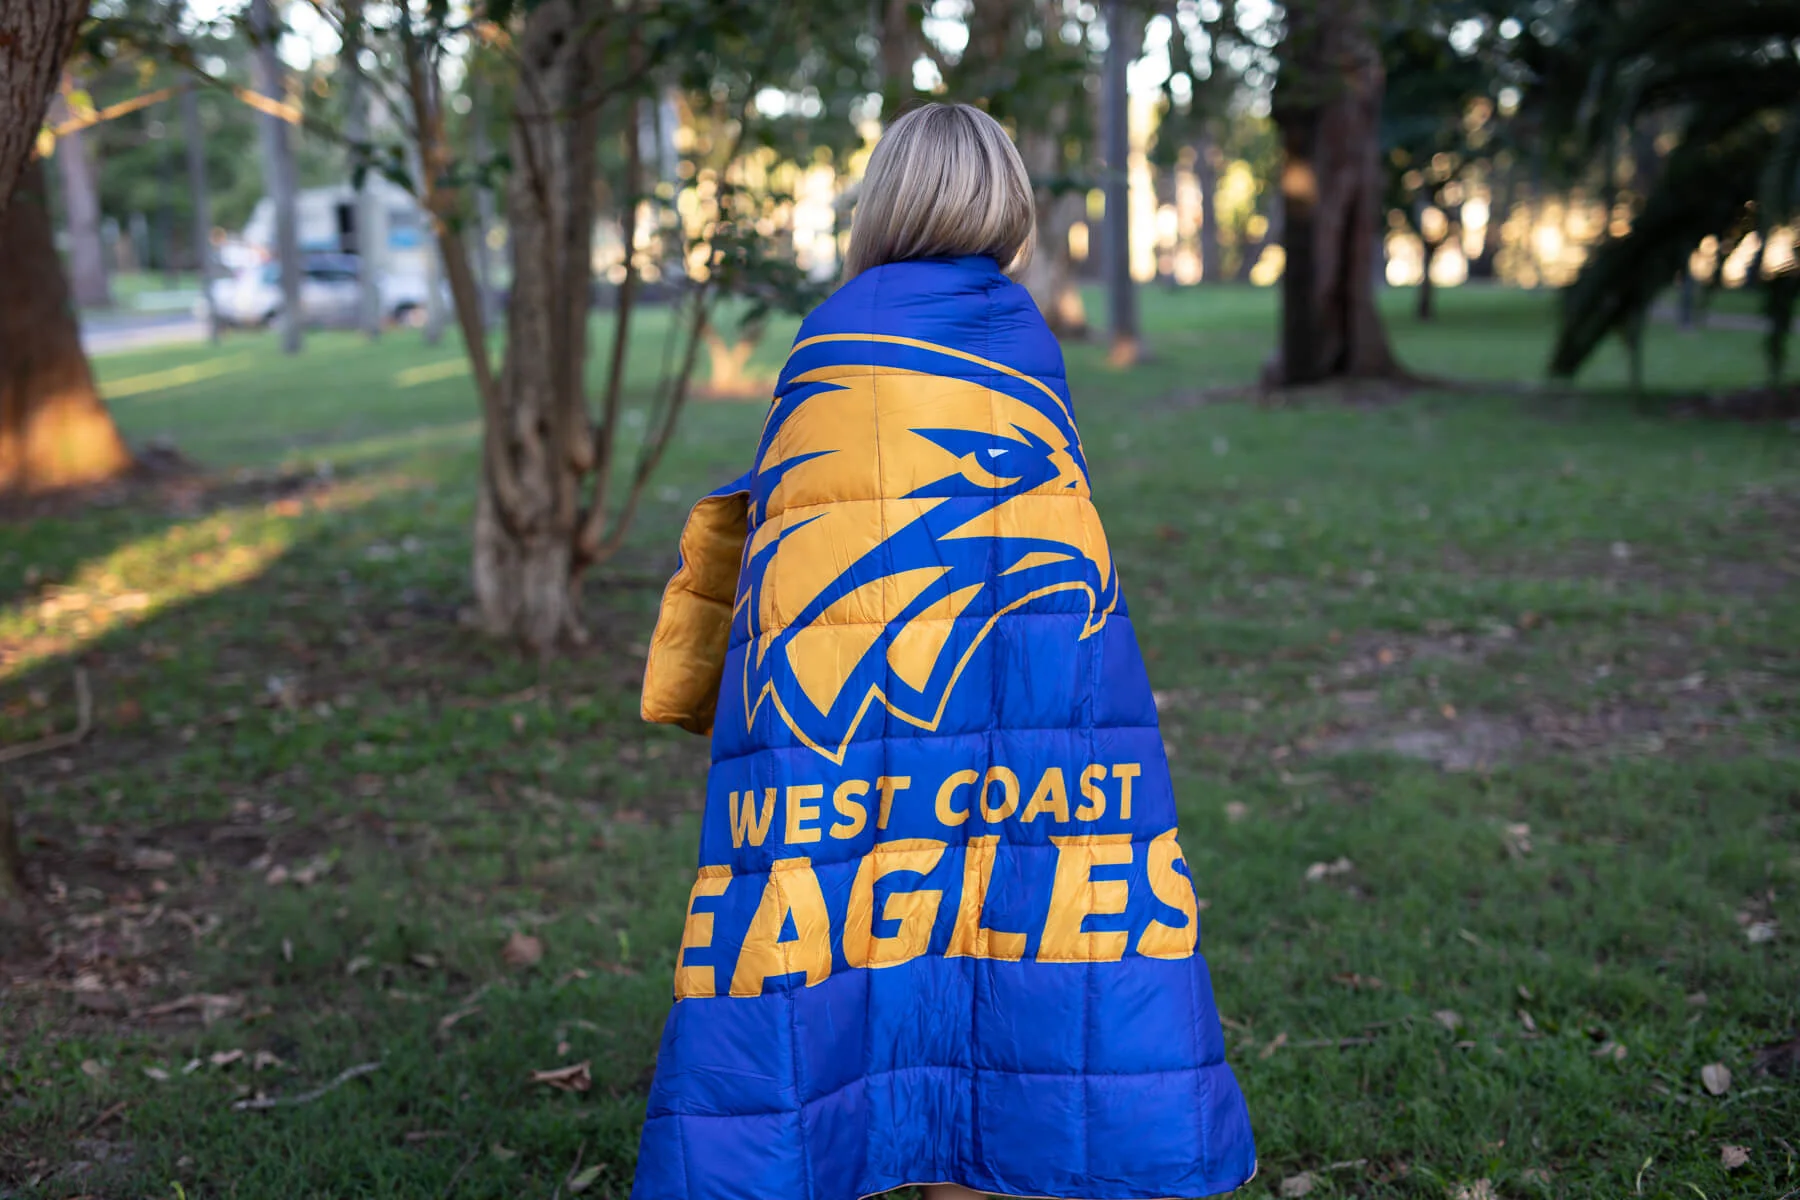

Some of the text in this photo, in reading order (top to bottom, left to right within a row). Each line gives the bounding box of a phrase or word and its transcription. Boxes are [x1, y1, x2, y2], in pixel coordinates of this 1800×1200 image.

[729, 763, 1141, 848] WEST COAST
[674, 827, 1198, 1000] EAGLES
